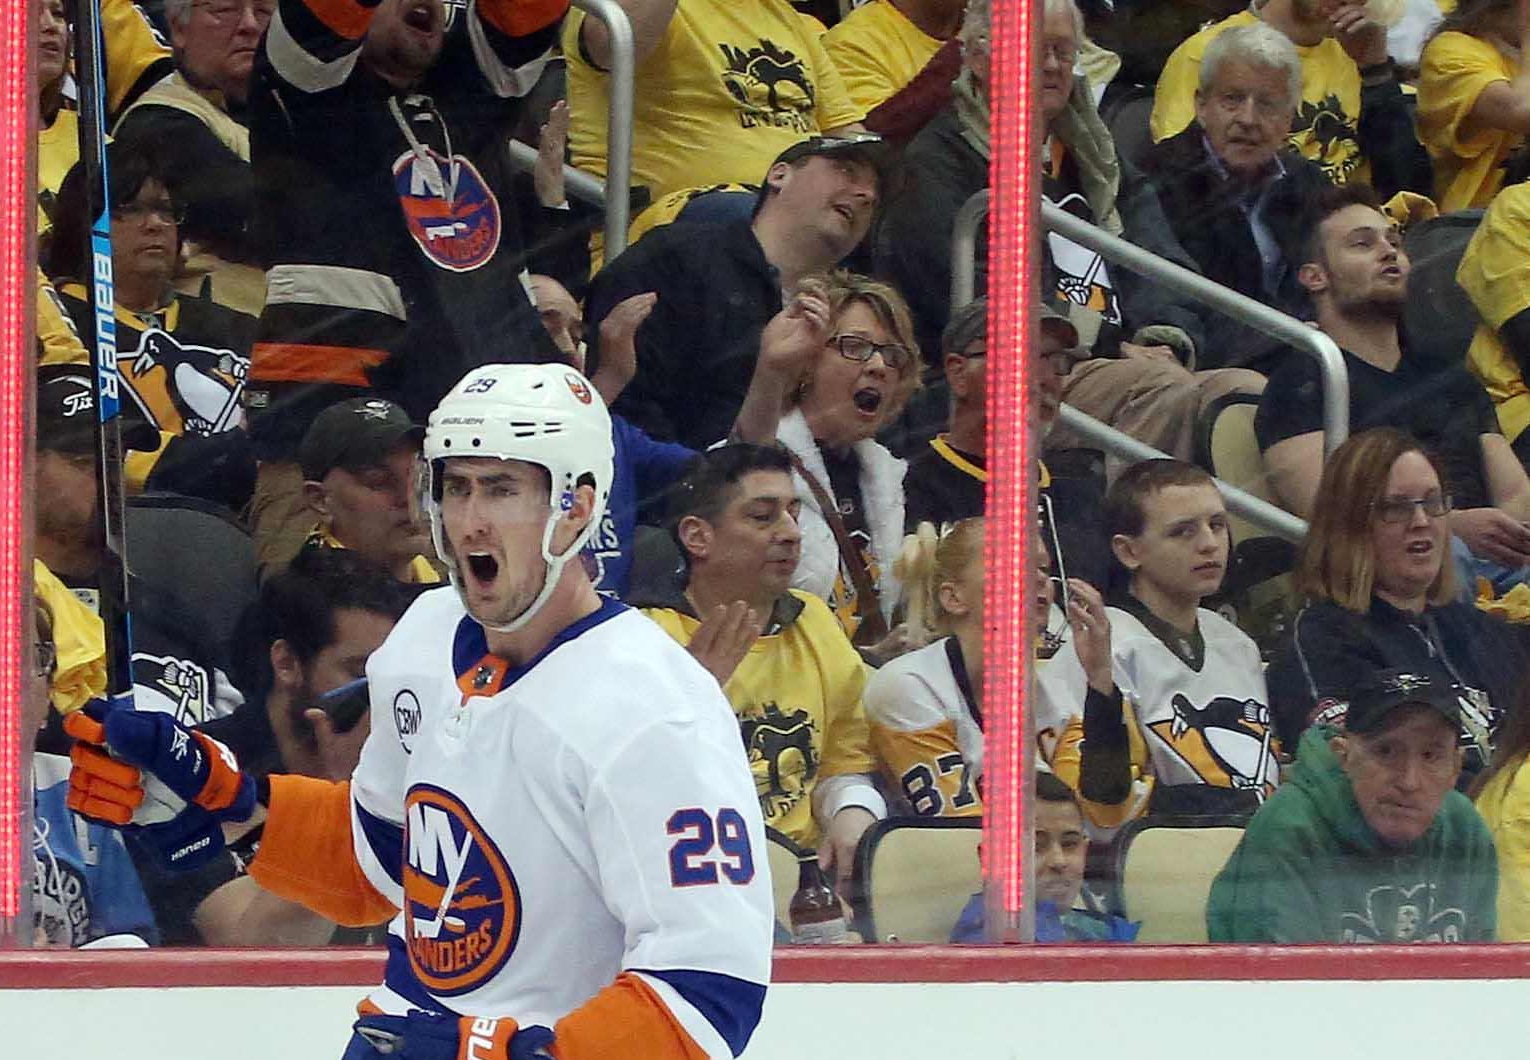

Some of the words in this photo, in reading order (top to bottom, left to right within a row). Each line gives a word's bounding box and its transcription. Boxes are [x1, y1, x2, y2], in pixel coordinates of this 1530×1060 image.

[92, 252, 119, 400] BAUER
[463, 378, 498, 393] 29
[901, 752, 978, 816] 87
[666, 808, 755, 888] 29
